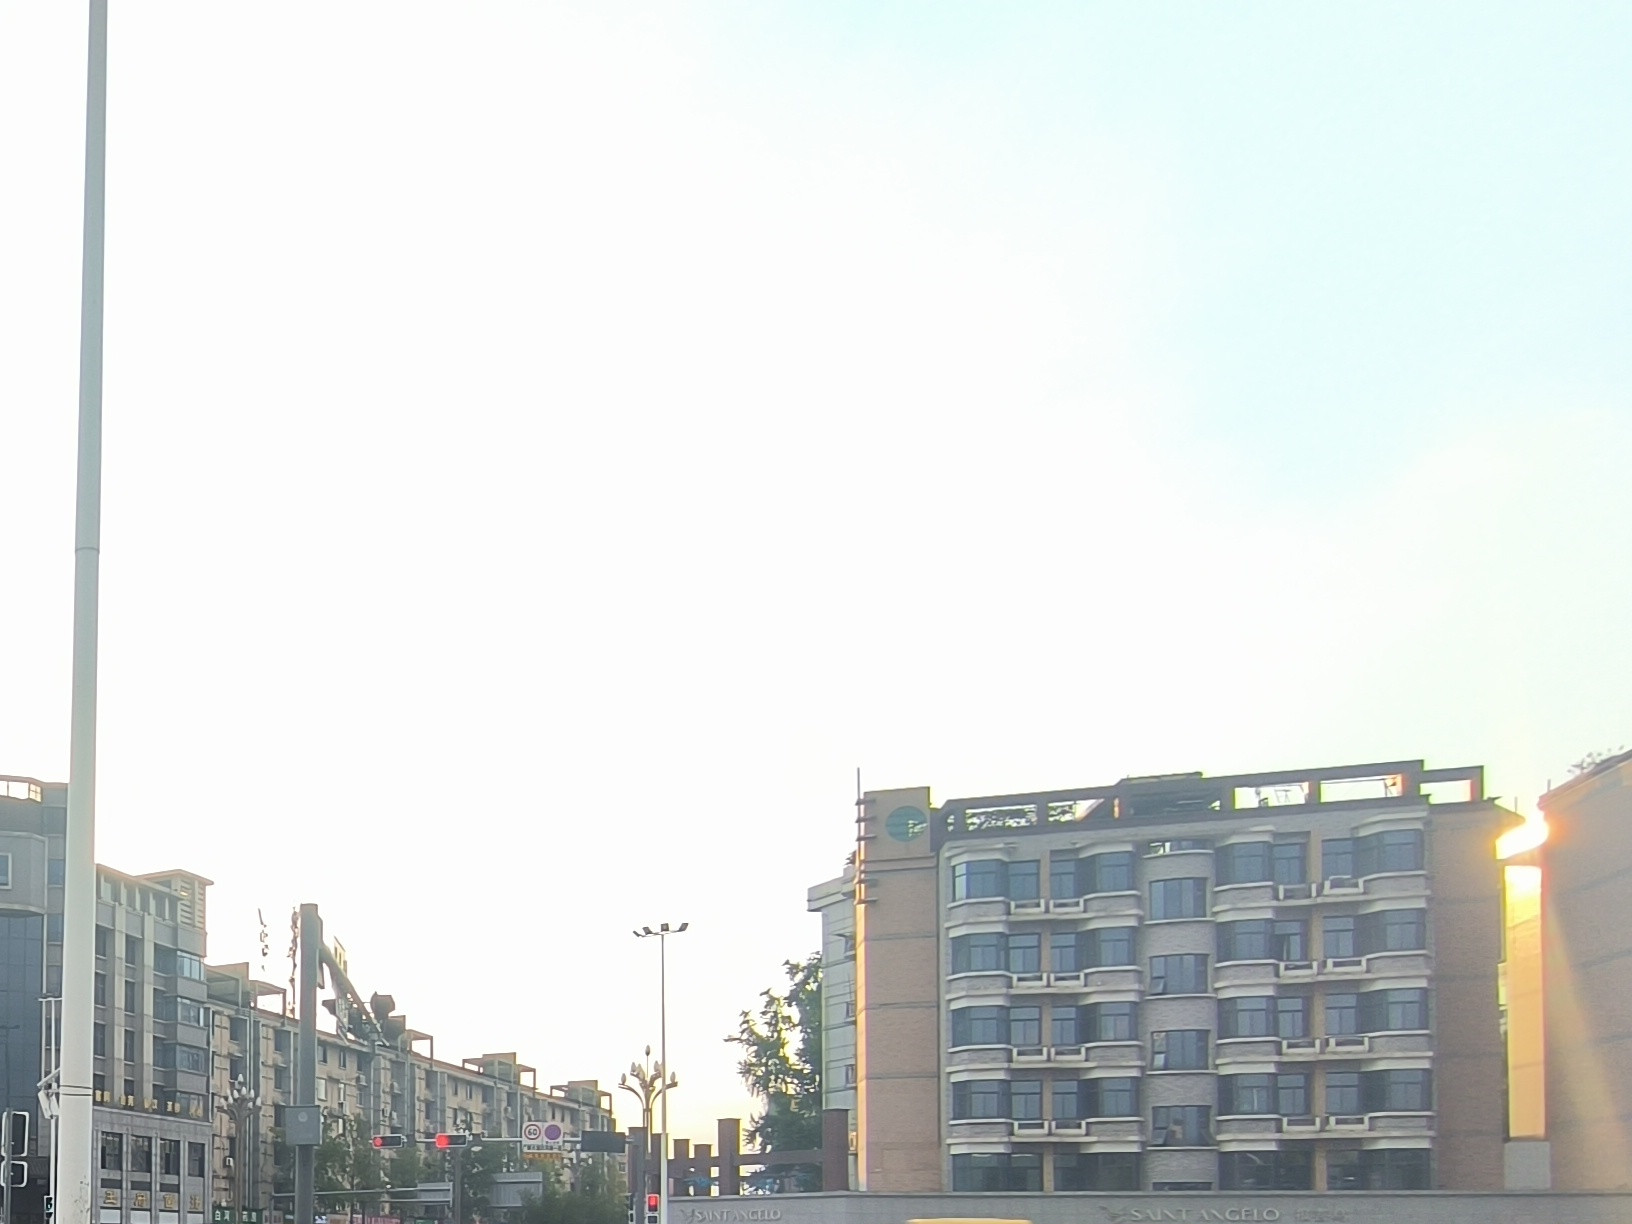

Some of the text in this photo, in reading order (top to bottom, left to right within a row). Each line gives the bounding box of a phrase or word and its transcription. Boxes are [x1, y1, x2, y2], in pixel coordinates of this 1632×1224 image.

[695, 1208, 782, 1221] SAINT ANGELO
[1130, 1207, 1280, 1221] SAINT ANGELO
